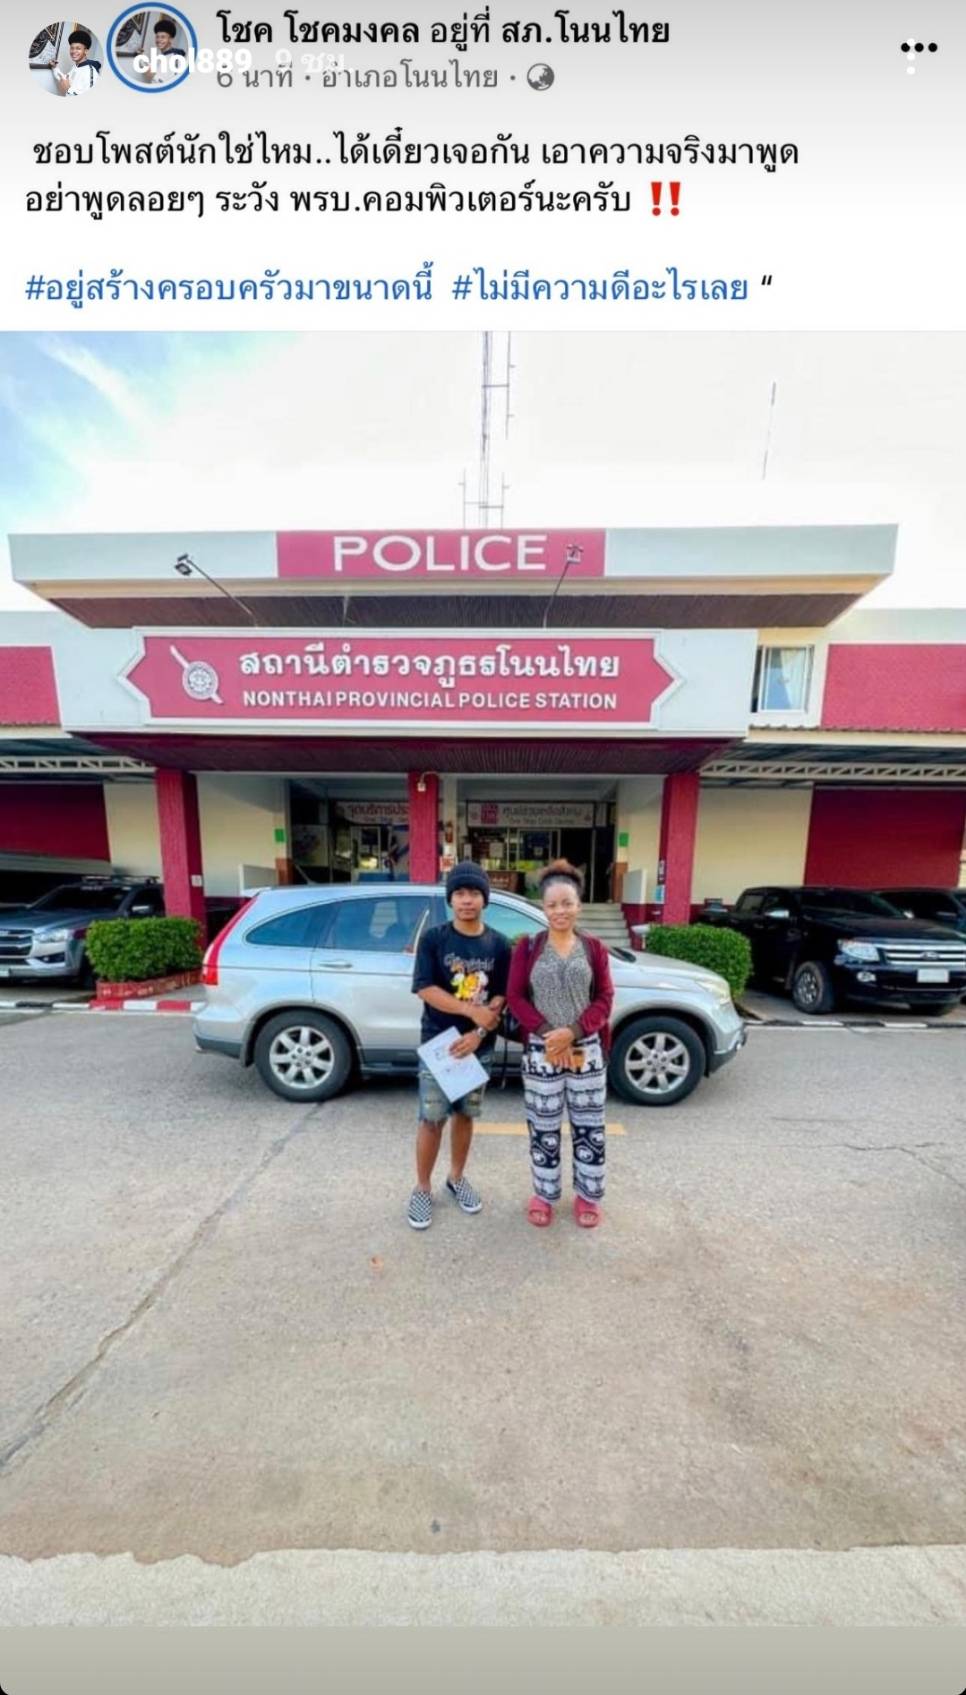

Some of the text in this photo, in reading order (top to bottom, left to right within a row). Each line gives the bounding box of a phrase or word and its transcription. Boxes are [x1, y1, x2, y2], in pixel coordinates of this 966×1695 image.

[333, 534, 548, 571] POLICE
[239, 642, 620, 688] สถานีตำรวจภูธรโนนไทย
[243, 690, 617, 710] NONTHAI PROVINCIAL POLICE STATION
